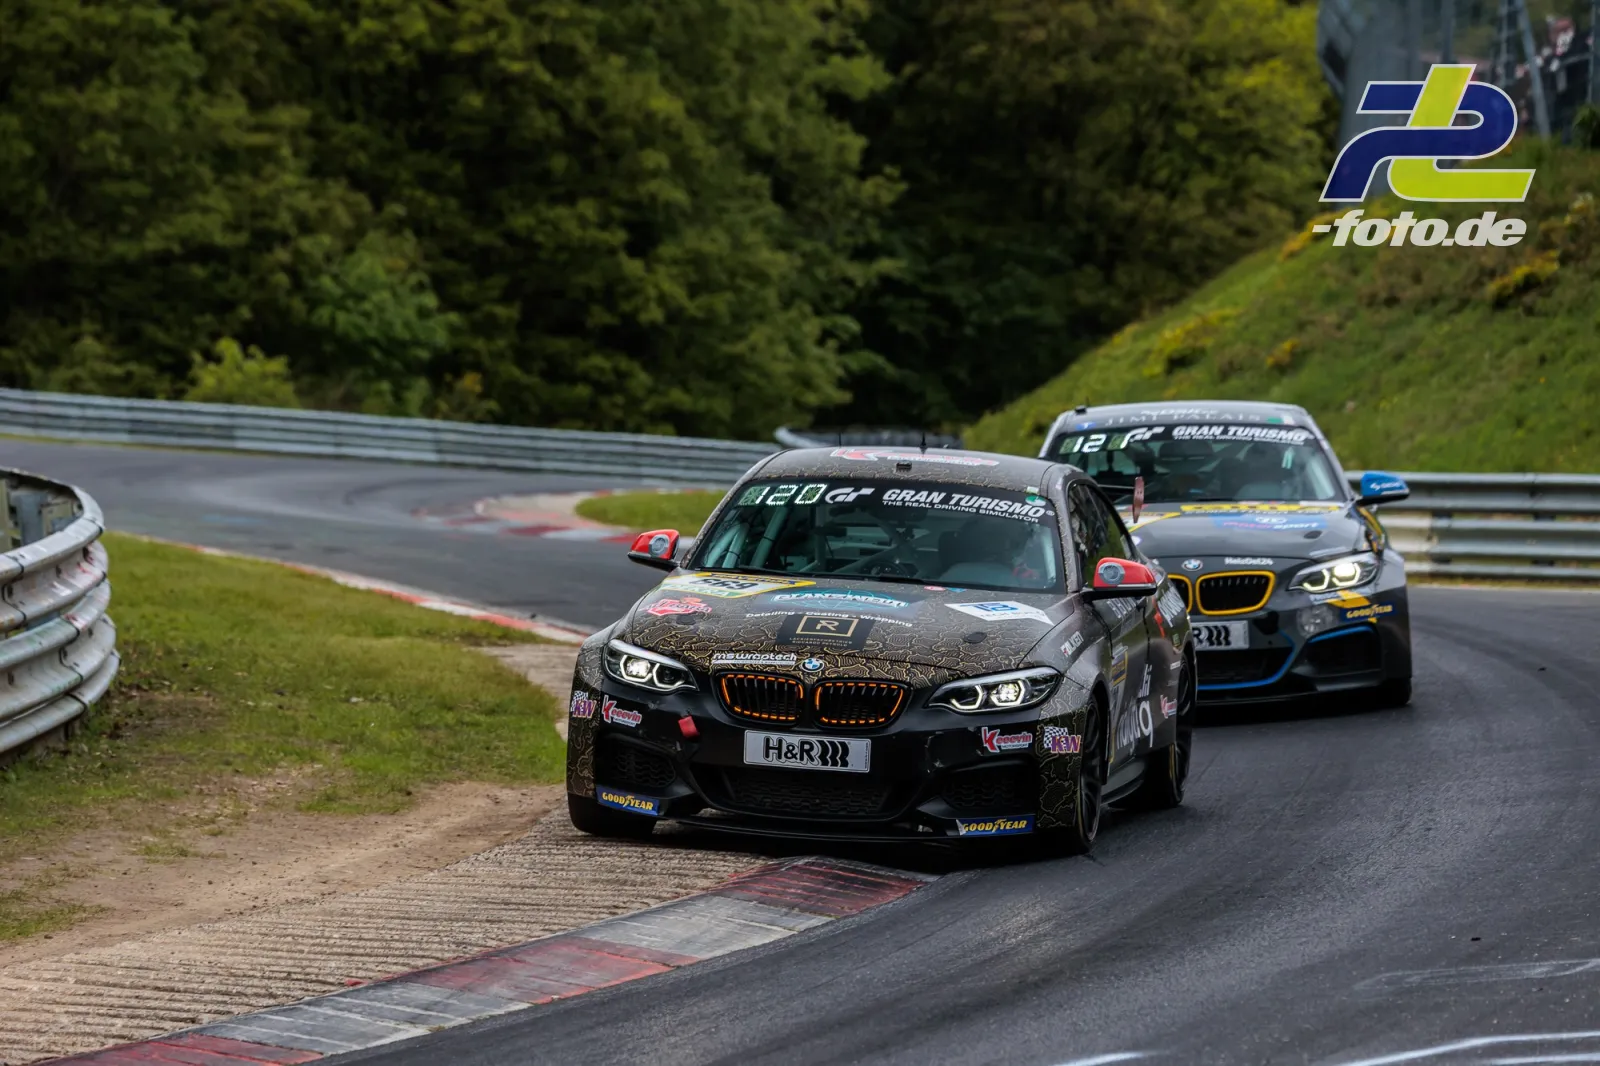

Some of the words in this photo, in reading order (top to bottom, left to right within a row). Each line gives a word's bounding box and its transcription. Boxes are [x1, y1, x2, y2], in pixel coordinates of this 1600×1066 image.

[1172, 425, 1224, 436] GRAN
[1227, 426, 1309, 442] TURISMO
[755, 484, 827, 504] 120
[882, 489, 946, 504] GRAN
[949, 494, 1046, 518] TURISMO
[905, 501, 932, 509] REAL
[934, 503, 977, 513] DRIVING
[979, 508, 1039, 523] SIMULATOR
[860, 614, 913, 627] Wrapping
[763, 737, 819, 765] H&R
[1051, 735, 1081, 753] KW
[602, 791, 654, 810] GOODYEAR
